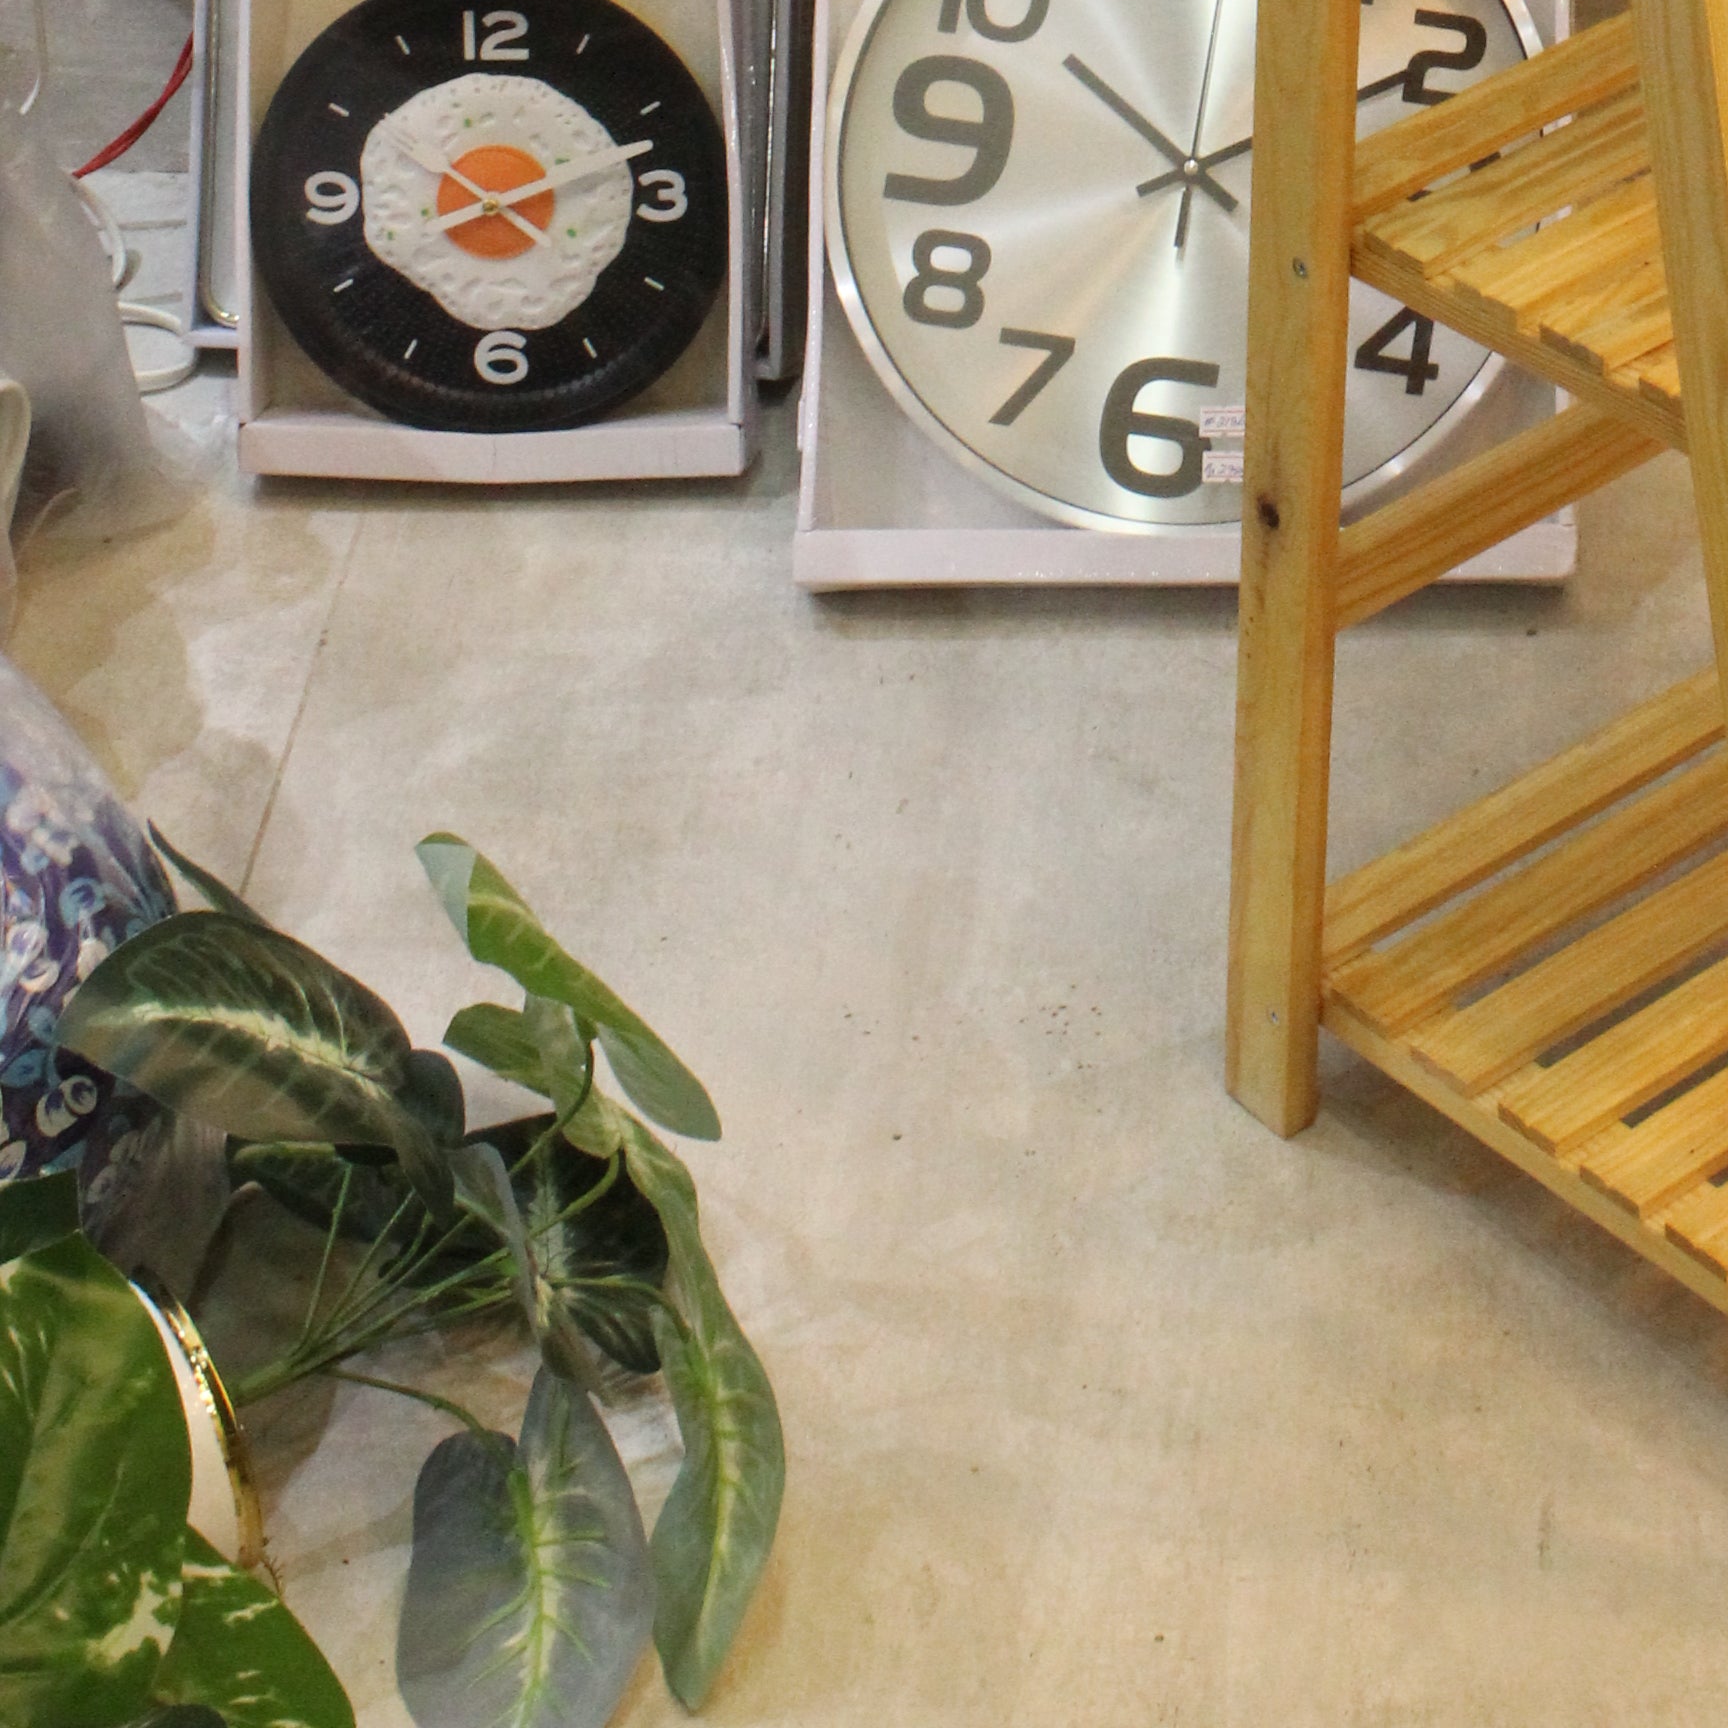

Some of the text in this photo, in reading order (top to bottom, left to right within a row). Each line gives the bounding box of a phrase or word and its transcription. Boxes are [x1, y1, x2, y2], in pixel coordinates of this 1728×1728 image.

[461, 10, 531, 62] 12
[1402, 9, 1488, 104] 2
[884, 55, 1016, 207] 9
[304, 171, 359, 224] 9
[635, 170, 689, 222] 3
[902, 229, 992, 330] 8
[473, 332, 530, 384] 6
[988, 327, 1075, 427] 7
[1354, 308, 1438, 395] 4
[1098, 357, 1220, 498] 6
